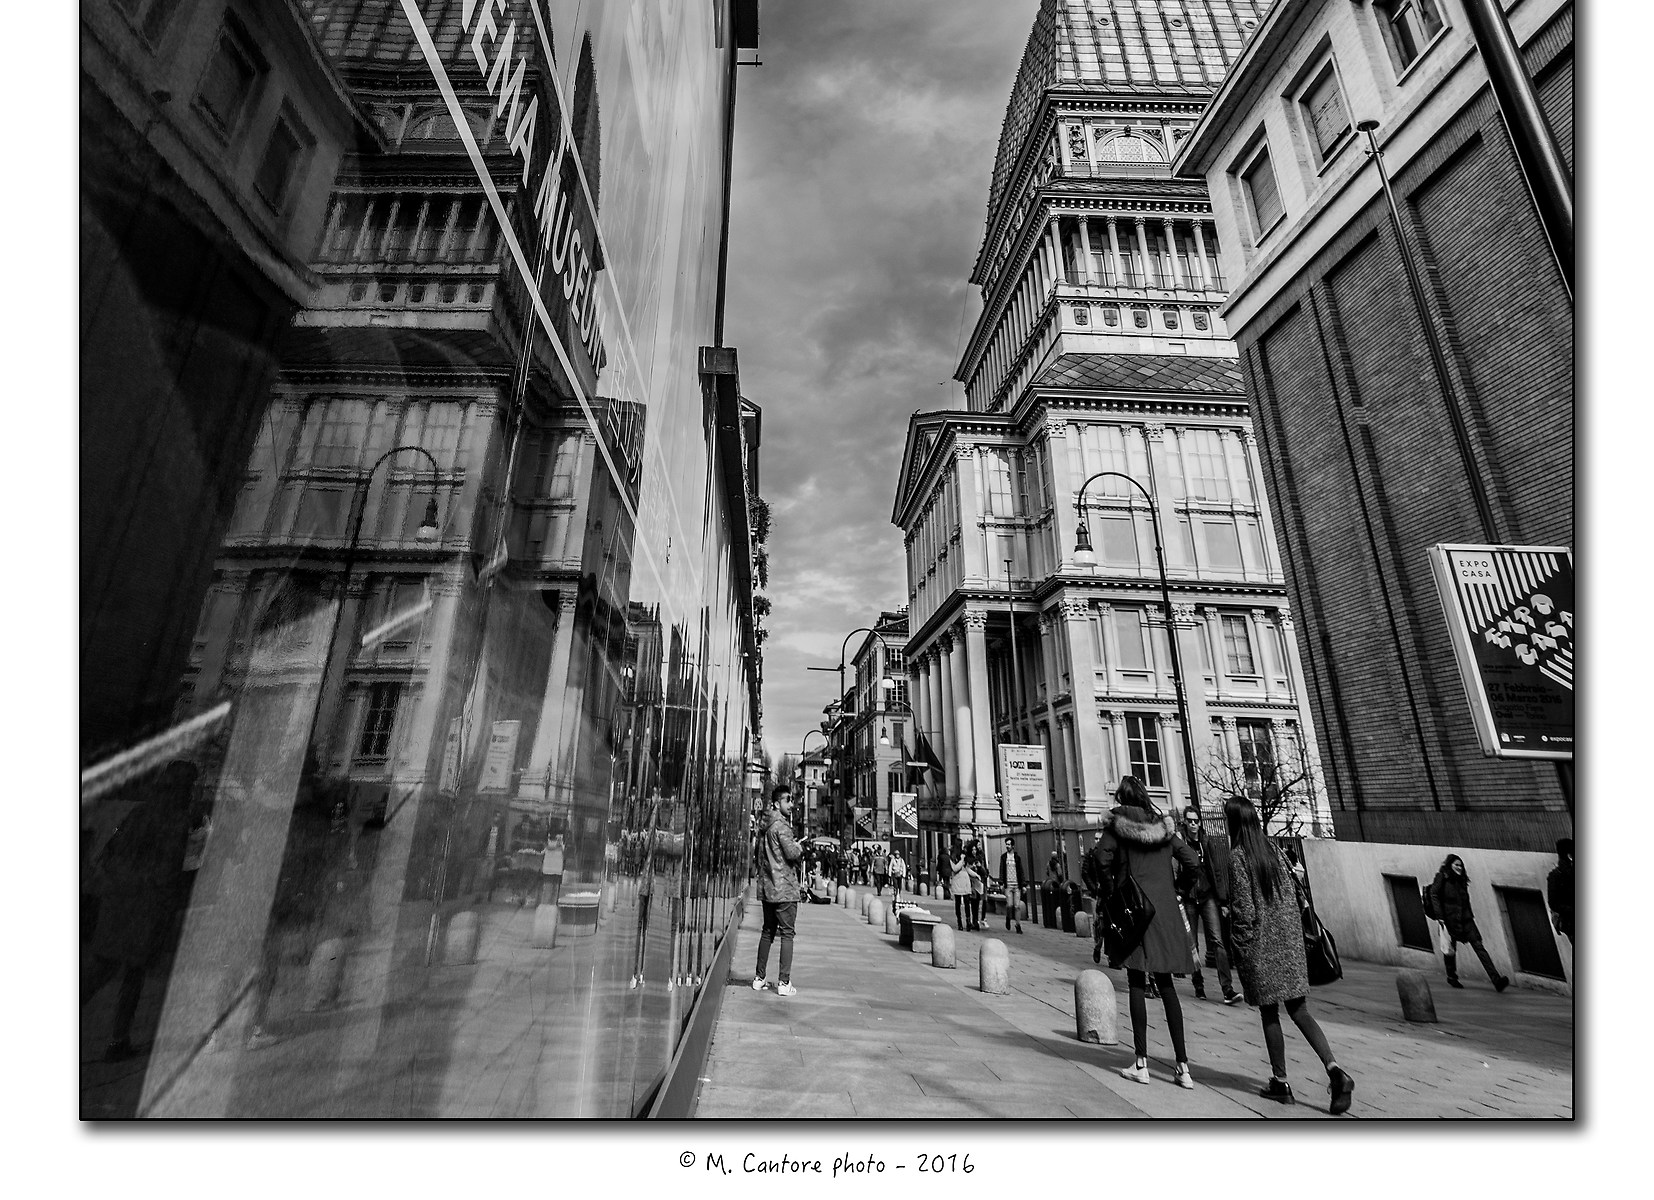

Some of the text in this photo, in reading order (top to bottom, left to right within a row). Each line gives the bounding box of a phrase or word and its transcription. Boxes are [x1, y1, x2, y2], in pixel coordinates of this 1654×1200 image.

[534, 150, 606, 376] MUSEUM
[1459, 560, 1488, 568] EXPO
[1488, 683, 1500, 692] 27
[1503, 683, 1546, 693] Febbraio
[1506, 693, 1538, 703] Marzo
